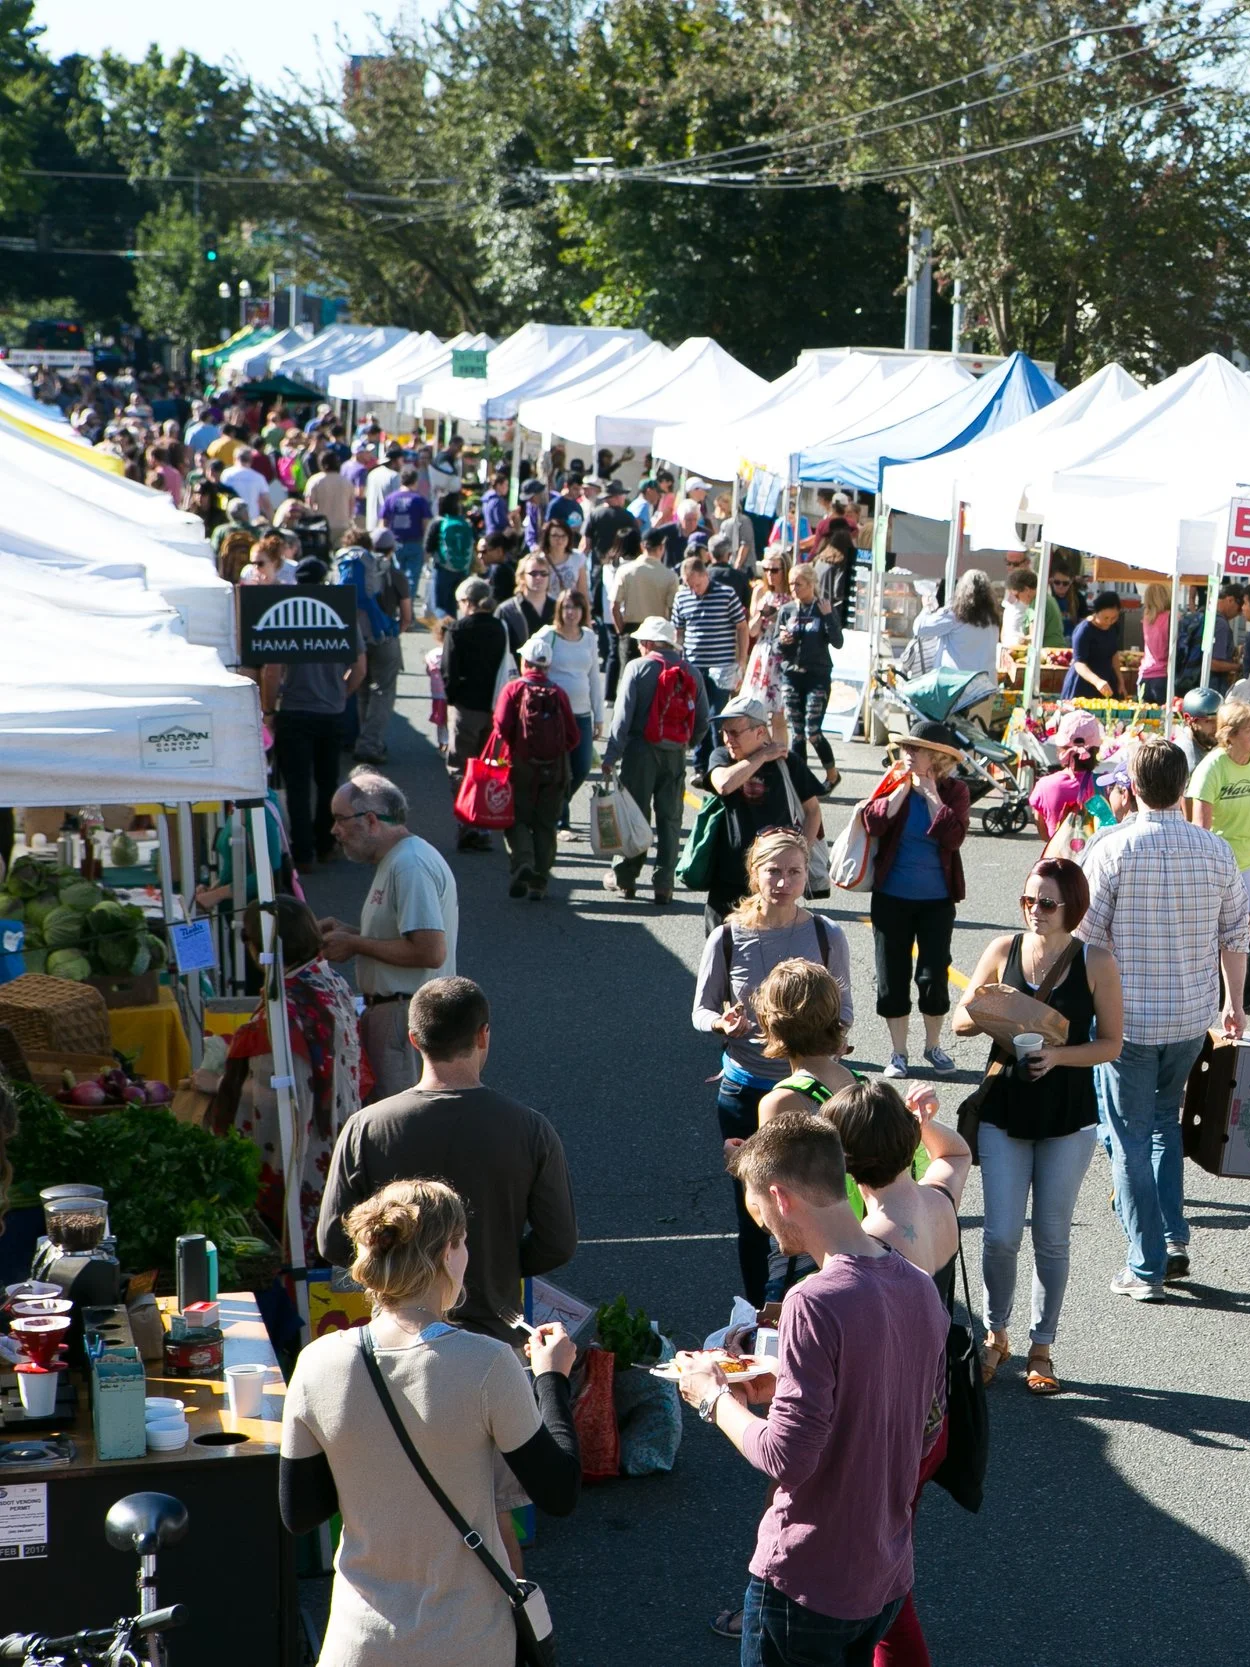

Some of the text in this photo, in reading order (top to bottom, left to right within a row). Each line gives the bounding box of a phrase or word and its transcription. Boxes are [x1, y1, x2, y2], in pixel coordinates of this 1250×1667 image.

[252, 638, 350, 651] HAMA HAMA
[0, 1545, 45, 1556] FEB 2017
